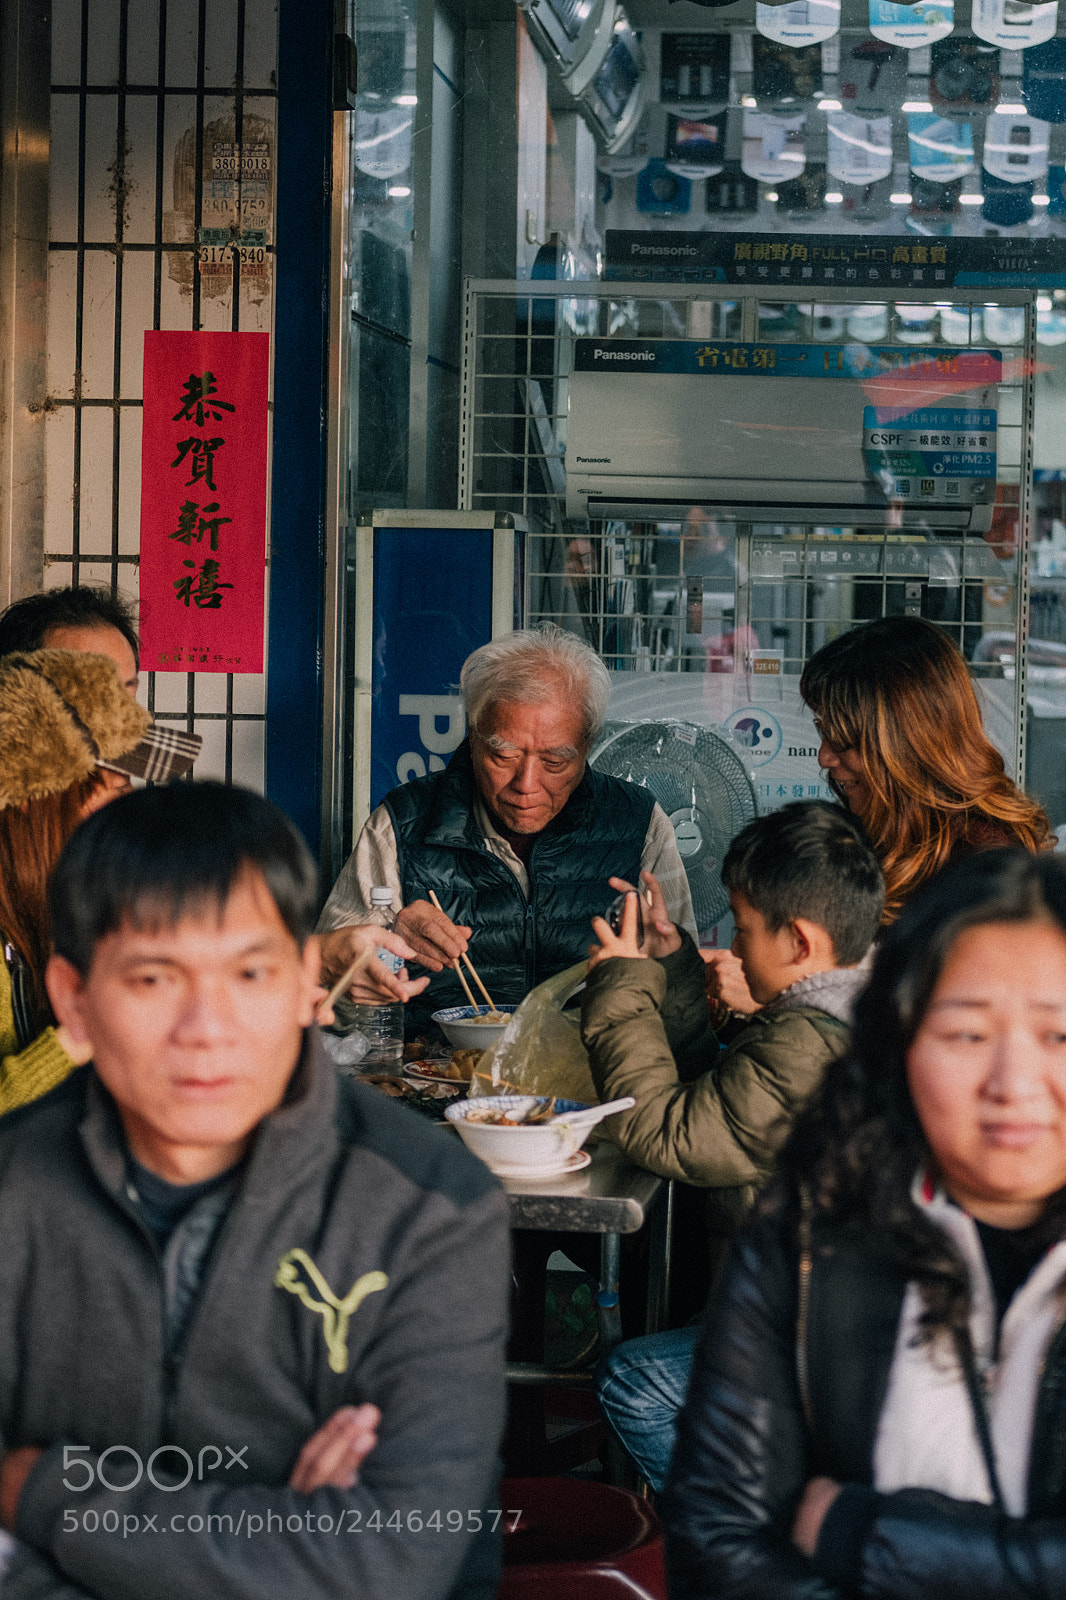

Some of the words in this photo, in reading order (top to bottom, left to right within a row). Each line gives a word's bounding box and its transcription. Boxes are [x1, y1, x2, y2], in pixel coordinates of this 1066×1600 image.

[202, 247, 264, 263] 317-840
[630, 243, 698, 256] Panasonic
[733, 243, 808, 261] 廣視野角
[892, 246, 947, 264] 高畫質
[593, 349, 656, 361] Panasonic
[694, 347, 808, 369] 省電第一
[870, 433, 904, 446] CSPF
[908, 434, 951, 447] 一級能效
[957, 436, 988, 447] 好省電
[168, 371, 236, 609] 恭賀新禧
